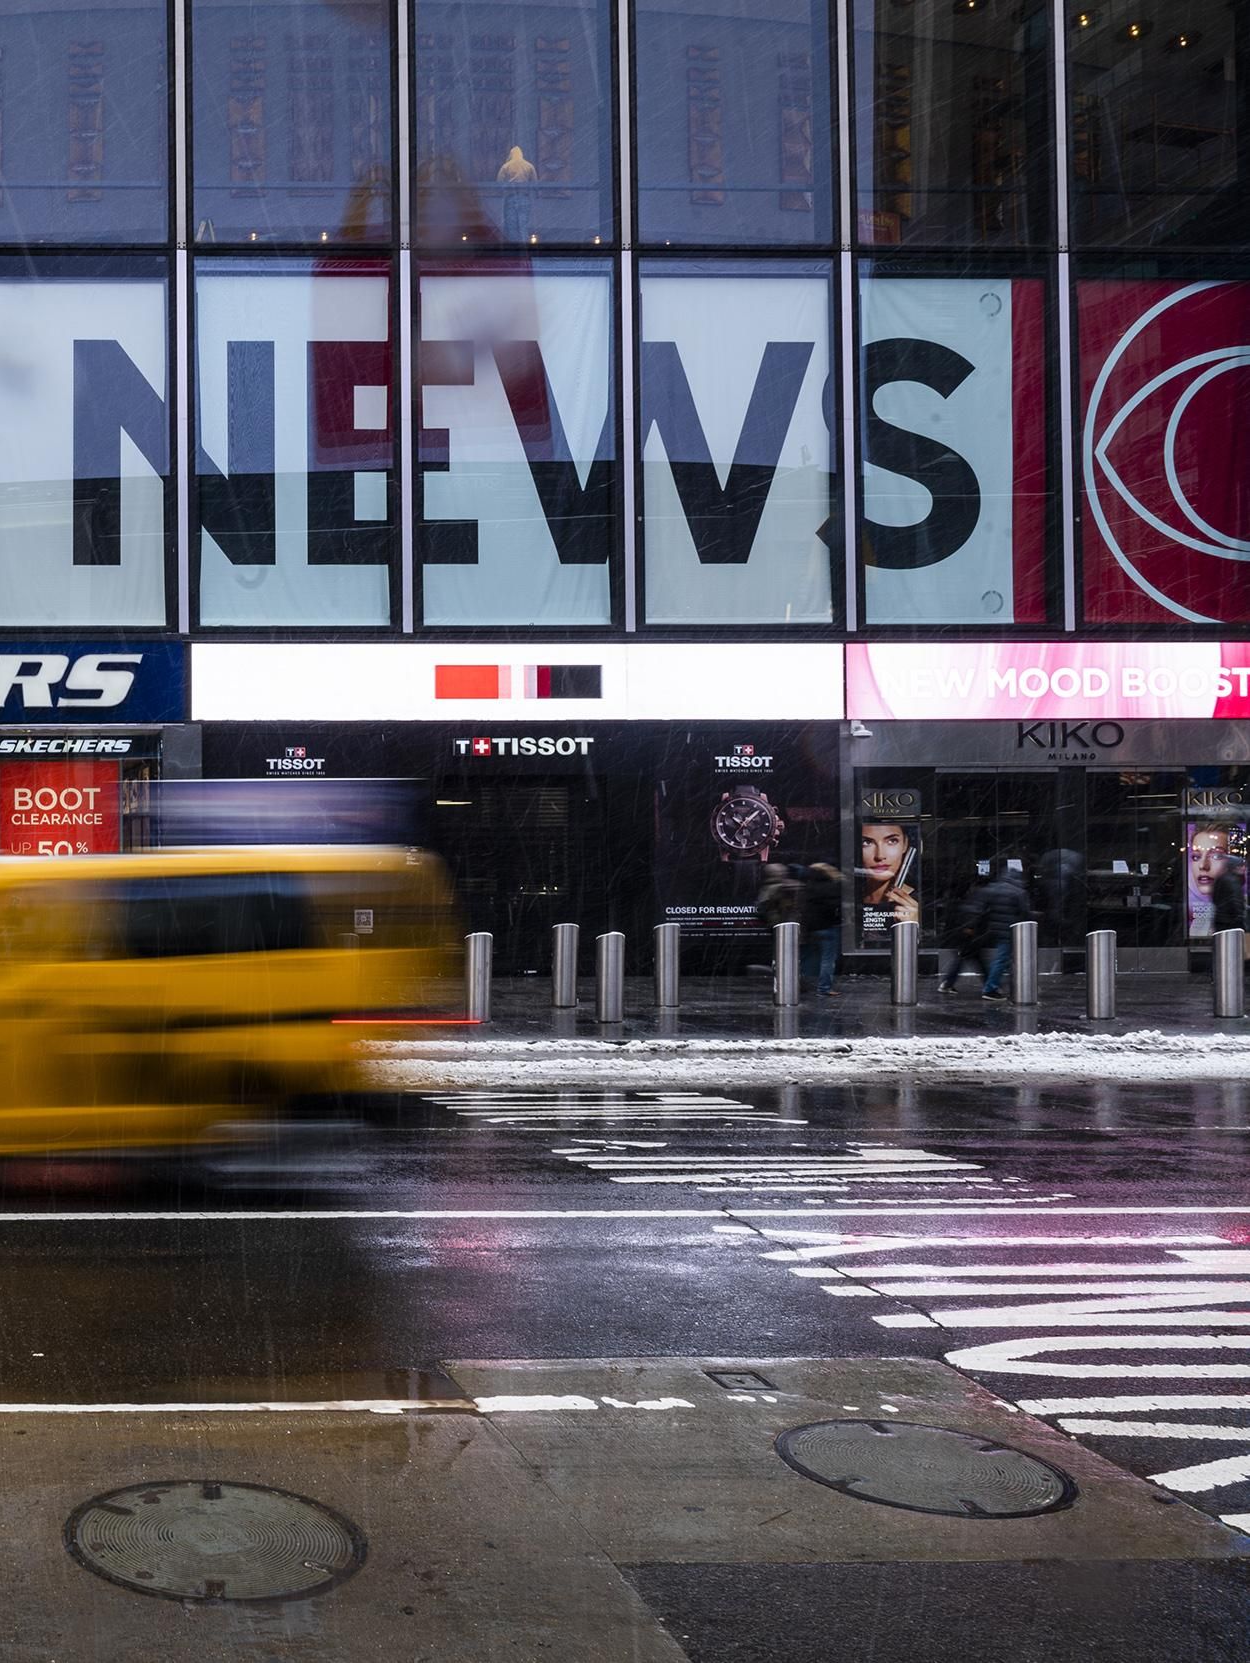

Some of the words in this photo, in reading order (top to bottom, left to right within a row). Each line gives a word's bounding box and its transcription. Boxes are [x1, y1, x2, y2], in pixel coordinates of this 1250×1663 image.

[72, 336, 982, 571] NEWS
[881, 668, 976, 698] NEW
[987, 667, 1110, 698] MOOD
[1016, 721, 1125, 749] KIKO
[491, 737, 594, 756] TISSOT
[714, 756, 773, 767] TISSOT
[1048, 752, 1097, 760] MILANO
[266, 758, 325, 770] TISSOT
[13, 787, 101, 811] BOOT
[1186, 791, 1243, 807] KIKO
[11, 813, 103, 825] CLEARANCE
[11, 842, 32, 854] UP
[665, 906, 698, 914] CLOSED
[699, 906, 715, 914] FOR
